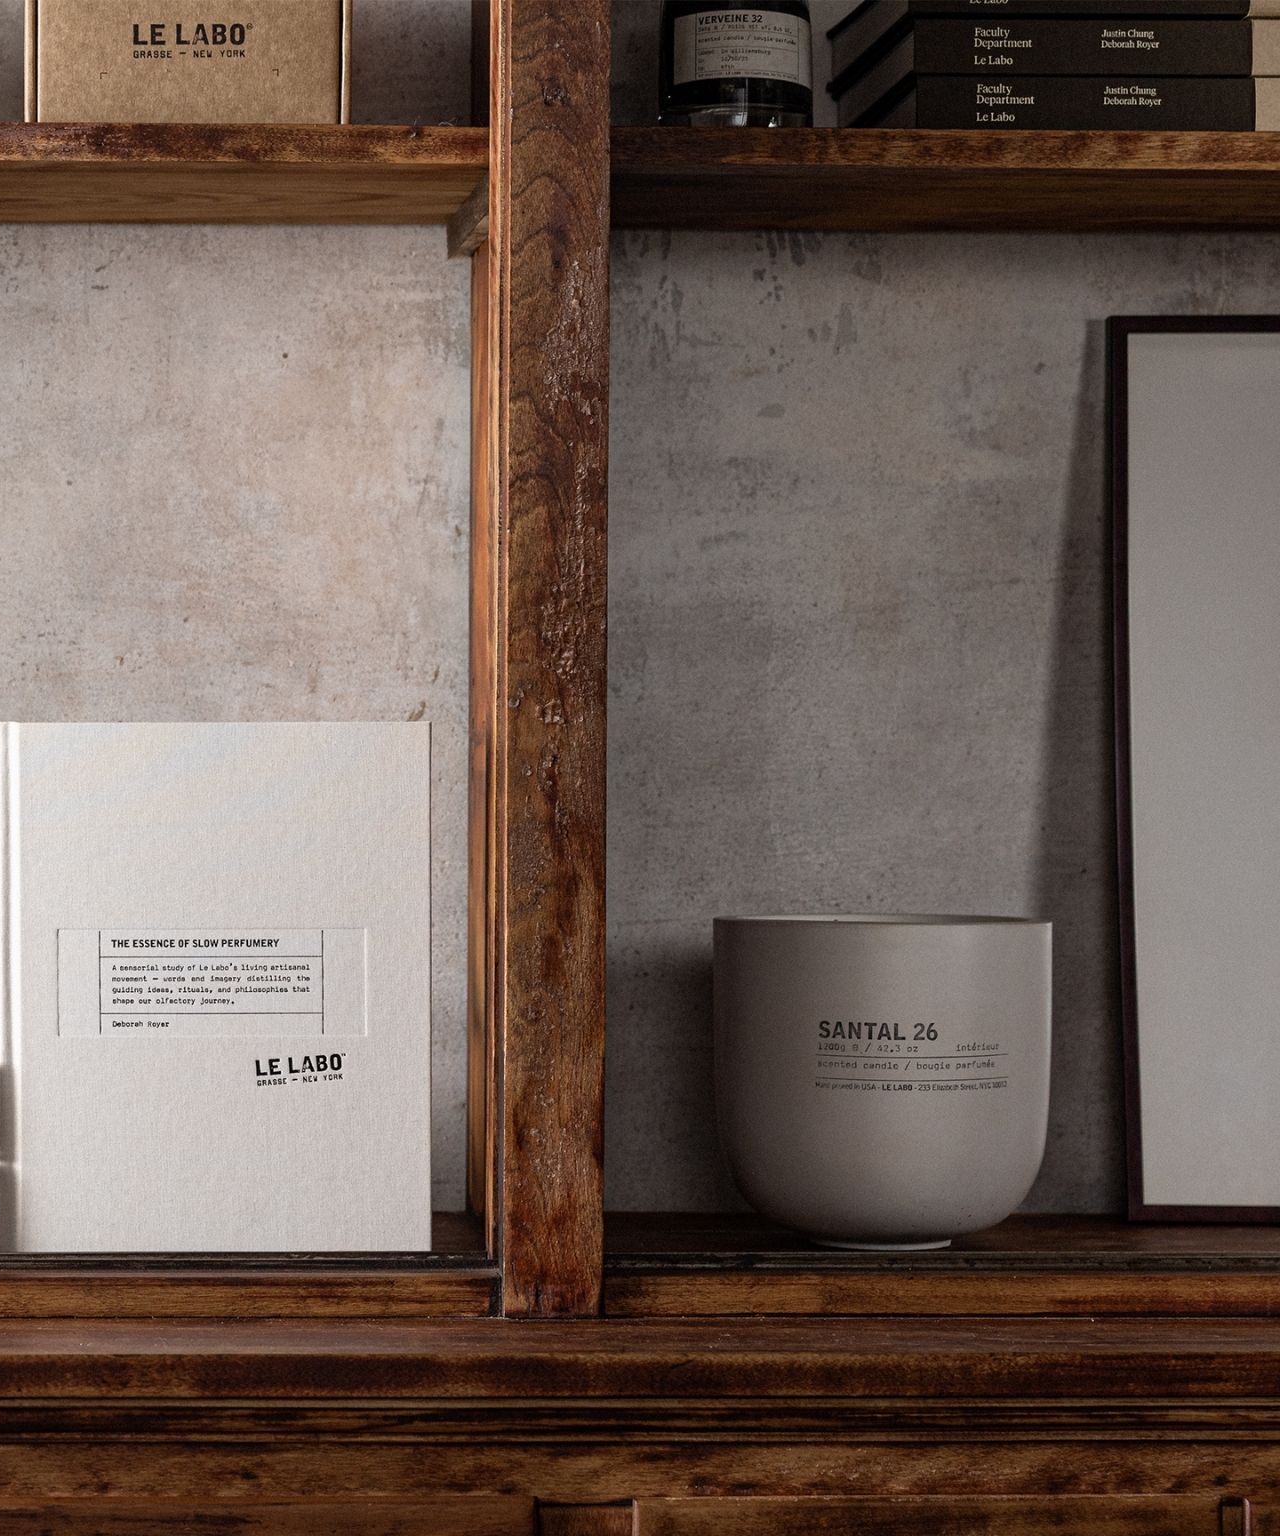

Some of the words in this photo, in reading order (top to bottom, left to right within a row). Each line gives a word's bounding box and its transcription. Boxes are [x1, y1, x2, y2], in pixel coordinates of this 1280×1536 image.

[698, 14, 749, 25] VERVEINE
[751, 14, 763, 23] 32
[133, 24, 166, 45] LE
[974, 27, 1010, 39] Faculty
[1101, 29, 1126, 38] Justin
[1127, 29, 1154, 40] Chung
[974, 38, 1033, 50] Department
[1101, 39, 1135, 49] Deborah
[1136, 40, 1160, 50] Royer
[133, 50, 173, 59] GRASSE
[193, 50, 212, 58] NEW
[220, 49, 246, 58] YORK
[974, 55, 986, 65] Le
[988, 55, 1013, 65] Labo
[976, 84, 1013, 95] Faculty
[1103, 86, 1128, 95] Justin
[1129, 86, 1156, 97] Chung
[976, 94, 1035, 107] Department
[1103, 96, 1137, 106] Deborah
[1138, 97, 1162, 107] Royer
[976, 112, 989, 122] Le
[990, 111, 1015, 122] Labo
[111, 939, 129, 948] THE
[132, 939, 176, 948] ESSENCE
[178, 939, 190, 948] OF
[192, 939, 219, 948] SLOW
[221, 939, 280, 948] PERFUMERY
[162, 964, 184, 973] study
[241, 963, 268, 973] living
[271, 963, 310, 971] artisanal
[210, 975, 242, 983] imagery
[247, 974, 292, 983] distilling
[112, 986, 143, 995] guiding
[147, 986, 174, 994] ideas,
[178, 986, 213, 994] rituals,
[235, 986, 289, 995] philosophies
[112, 997, 135, 1006] shape
[156, 997, 196, 1006] olfactory
[201, 997, 235, 1006] journey.
[112, 1020, 144, 1028] Deborah
[147, 1020, 170, 1029] Royer
[818, 1020, 906, 1041] SANTAL
[913, 1022, 938, 1041] 26
[818, 1042, 846, 1053] 1200g
[877, 1044, 901, 1053] 42.3
[907, 1045, 919, 1053] oz
[255, 1058, 282, 1077] LE
[817, 1059, 857, 1069] scented
[863, 1060, 899, 1070] candle
[916, 1061, 951, 1071] bougie
[955, 1059, 996, 1070] parfumée
[257, 1077, 288, 1087] GRASSE
[302, 1075, 318, 1083] NEW
[323, 1073, 344, 1081] YORK
[861, 1083, 876, 1091] USA
